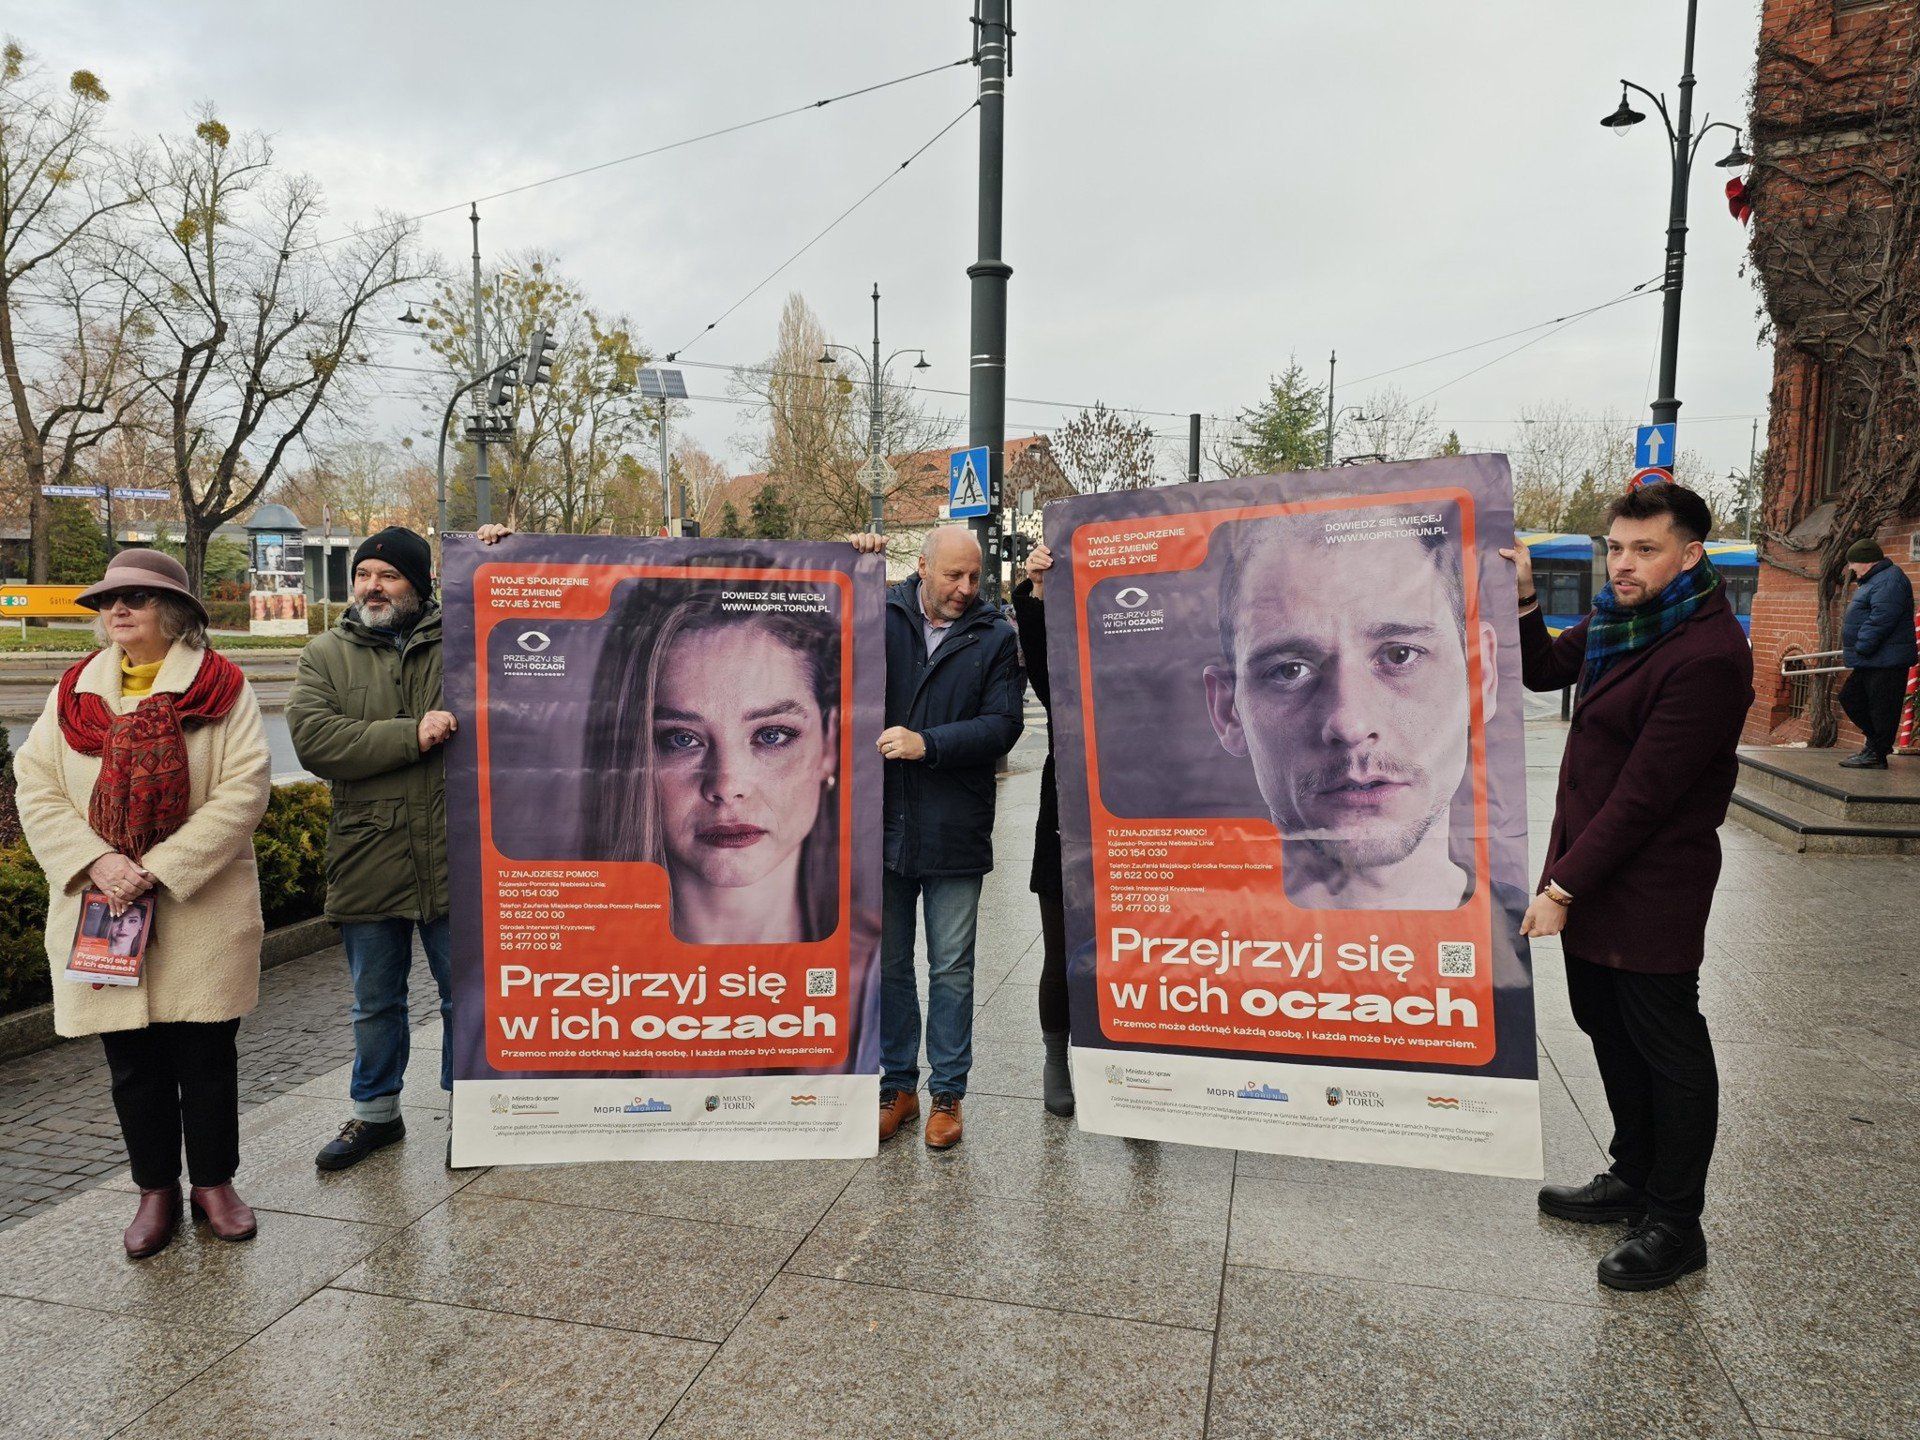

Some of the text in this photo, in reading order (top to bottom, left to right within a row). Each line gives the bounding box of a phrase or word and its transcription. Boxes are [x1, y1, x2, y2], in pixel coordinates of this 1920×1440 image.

[1325, 512, 1442, 532] DOWIEDZ SIĘ WIĘCEJ
[1087, 528, 1185, 545] TWOJE SPOJRZENIE
[1325, 526, 1449, 543] WWW.MOPR.TORUN.PL
[1088, 541, 1158, 557] MOŻE ZMIENIĆ
[1088, 554, 1158, 568] CZYJEŚ ŻYCIE
[490, 575, 589, 586] TWOJE SPOJRZENIE
[490, 586, 562, 597] MOŻE ZMIENIĆ
[721, 591, 826, 602] DOWIEDZ SIĘ WIĘCEJ
[0, 596, 27, 606] E 30
[491, 599, 561, 609] CZYJEŚ ŻYCIE
[721, 603, 831, 613] WWW.MOPR.TORUN.PL
[1102, 608, 1164, 622] PRZEJRZYJ SIĘ
[1128, 617, 1164, 626] OCZACH
[503, 654, 566, 666] PRZEJRZYJ SIĘ
[1106, 828, 1208, 837] TU ZNAJDZIESZ POMOC!
[1108, 848, 1168, 857] 800 154 030
[511, 870, 564, 878] ZNAJDZIESZ
[565, 870, 599, 878] POMOC!
[1109, 870, 1174, 880] 56 622 00 00
[498, 888, 560, 898] 800 154 030
[1110, 893, 1169, 903] 56 477 00 91
[1110, 903, 1171, 913] 56 477 00 92
[499, 910, 565, 919] 56 622 00 00
[500, 932, 560, 941] 56 477 00 91
[500, 941, 562, 951] 56 477 00 92
[1111, 927, 1415, 983] Przejrzyj się
[500, 965, 786, 1004] Przejrzyj się
[1110, 976, 1479, 1028] w ich oczach
[500, 1005, 836, 1040] w ich oczach
[1113, 1018, 1477, 1049] Przemoc może dotknąć każdą osobę. I każda może być wsparciem.
[501, 1049, 547, 1058] Przemoc
[548, 1049, 577, 1057] może
[578, 1049, 621, 1058] dotknąć
[622, 1049, 654, 1058] każdą
[655, 1049, 688, 1058] osobę.
[695, 1049, 726, 1057] każda
[728, 1048, 756, 1056] może
[757, 1047, 776, 1056] być
[778, 1047, 834, 1055] wsparciem.
[1206, 1088, 1235, 1098] MOPR
[1345, 1089, 1381, 1099] MIASTO
[723, 1100, 756, 1110] TORUŃ
[1346, 1097, 1384, 1108] TORUŃ
